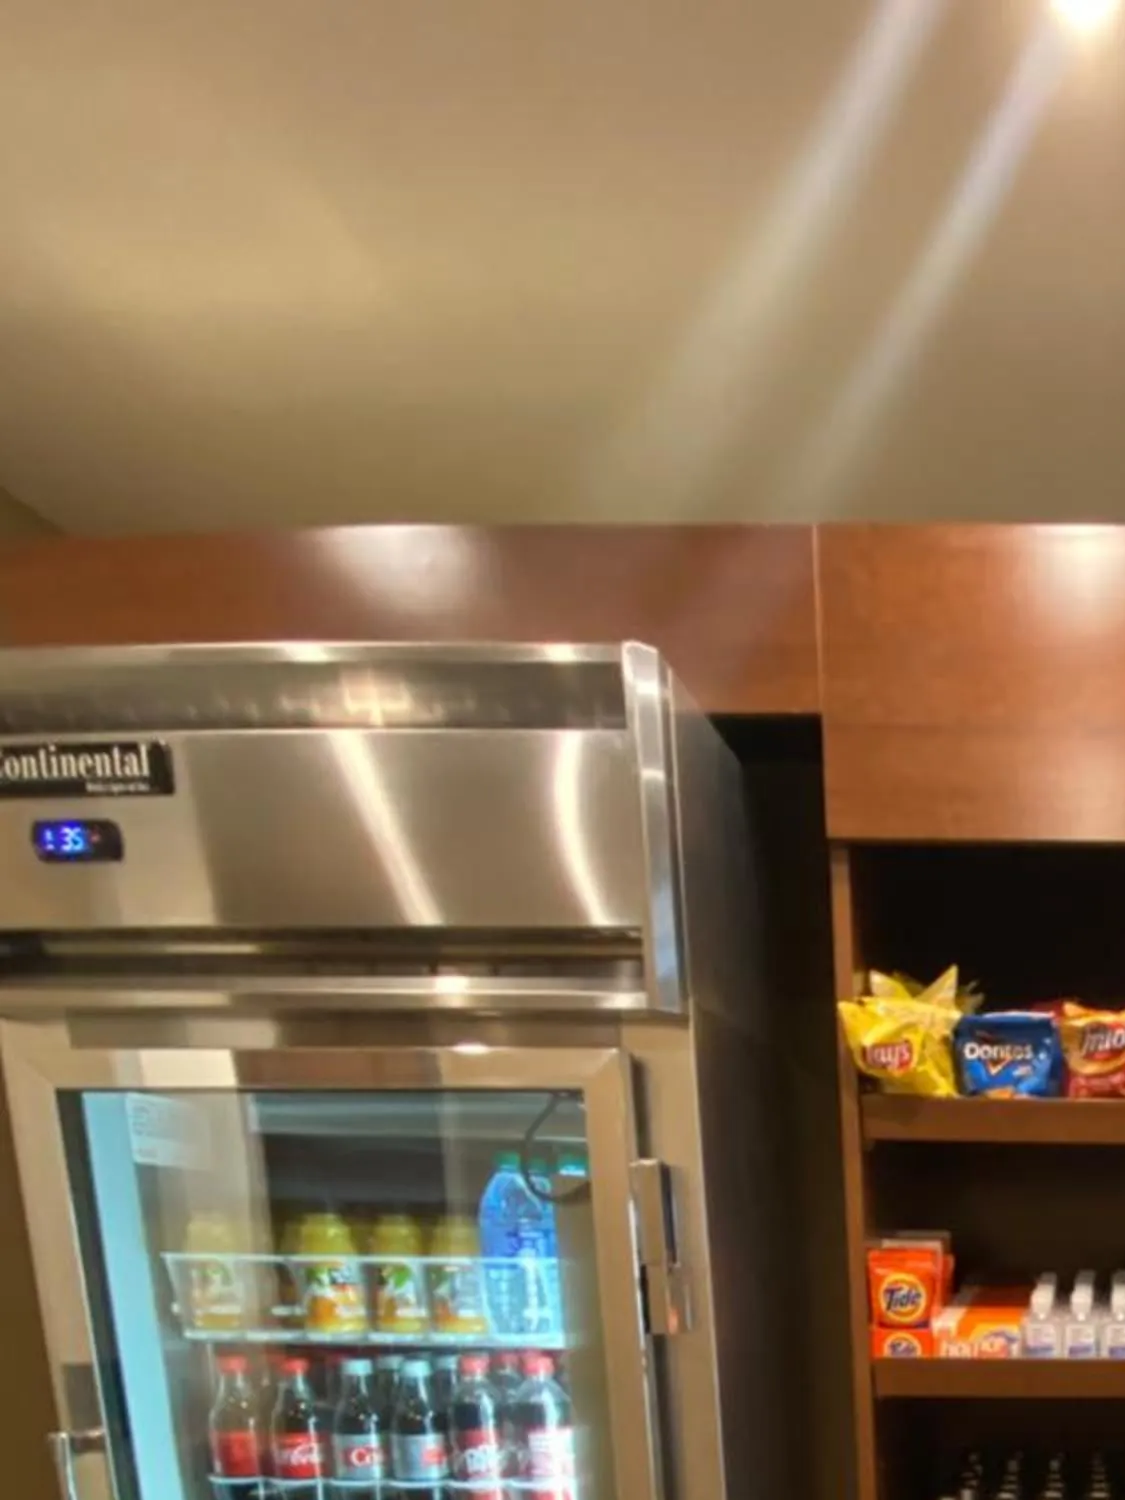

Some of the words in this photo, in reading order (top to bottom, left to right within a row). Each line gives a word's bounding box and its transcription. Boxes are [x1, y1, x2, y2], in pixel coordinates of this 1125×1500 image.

[0, 744, 149, 779] ontinental
[964, 1042, 1033, 1060] Doritos
[884, 1286, 922, 1312] Tide
